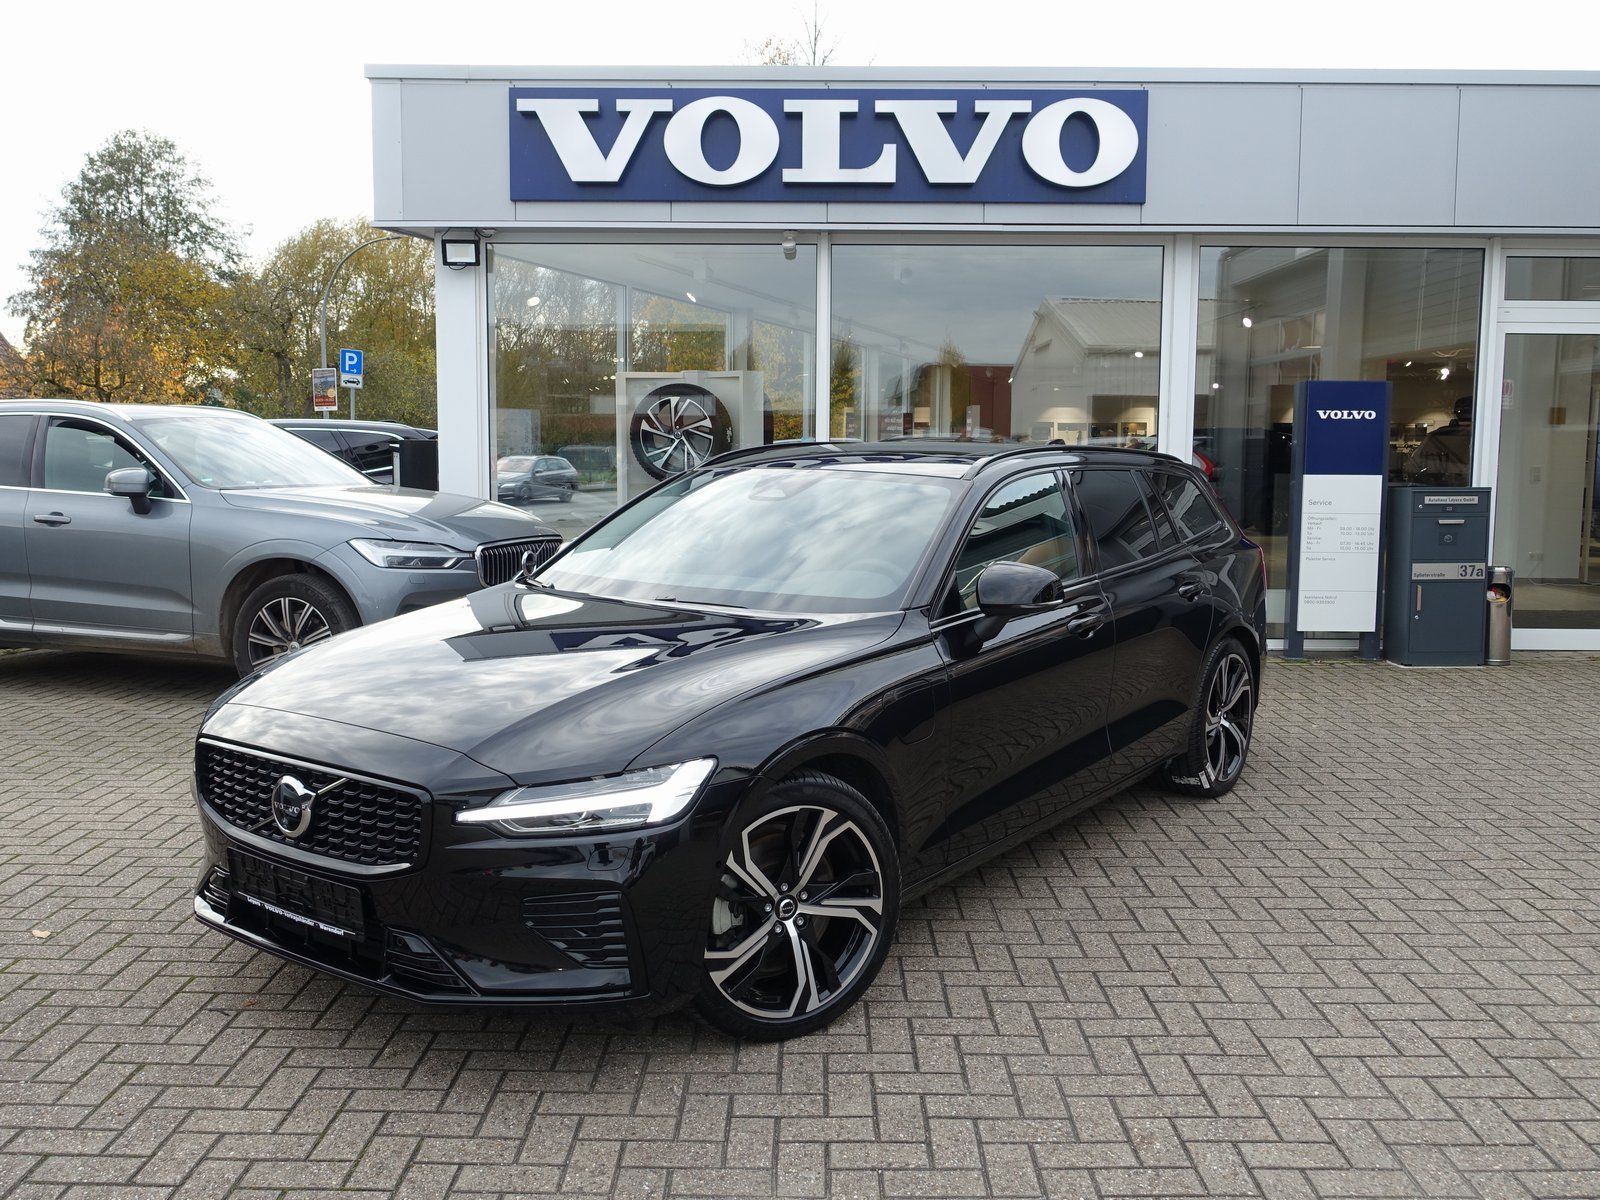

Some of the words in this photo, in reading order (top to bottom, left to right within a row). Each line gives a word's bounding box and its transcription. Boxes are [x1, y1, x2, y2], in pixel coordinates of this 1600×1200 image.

[516, 96, 1139, 188] VOLVO
[345, 352, 358, 371] P
[1316, 410, 1377, 420] VOLVO
[1459, 564, 1484, 577] 37a
